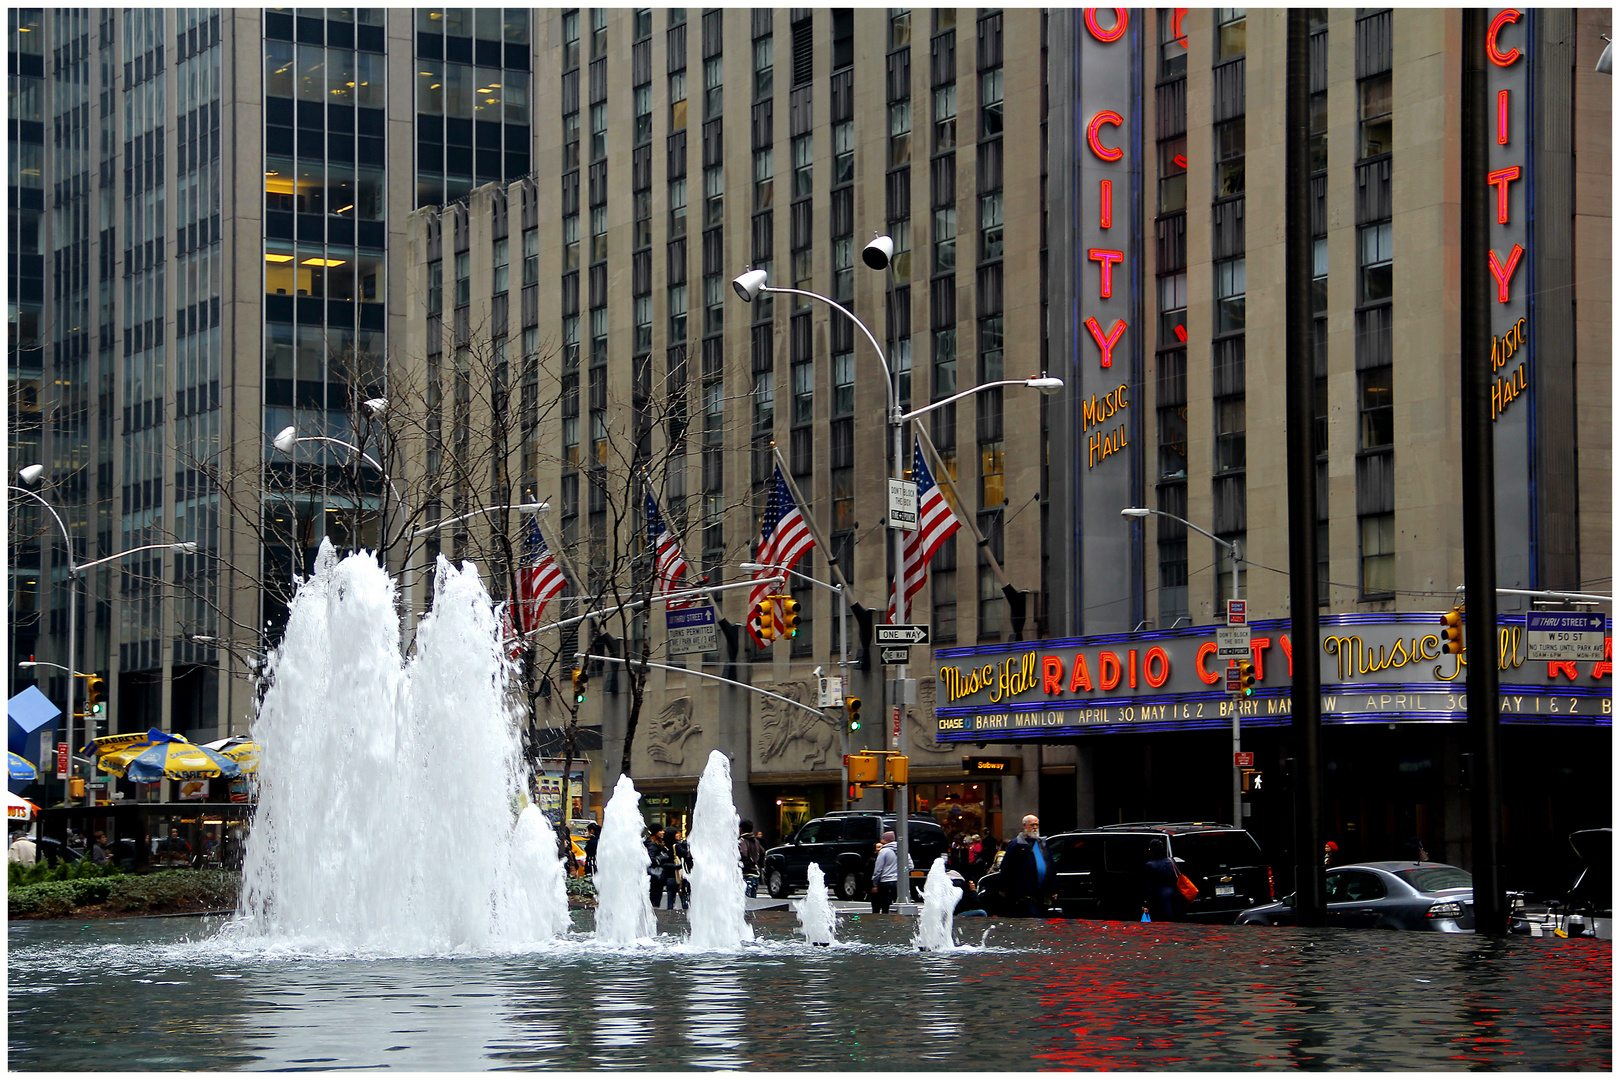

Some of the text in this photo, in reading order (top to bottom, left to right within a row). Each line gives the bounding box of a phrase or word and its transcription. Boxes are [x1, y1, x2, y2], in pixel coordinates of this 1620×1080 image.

[1487, 8, 1523, 303] CITY
[1086, 109, 1128, 368] CITY
[1491, 363, 1527, 420] HALL
[1083, 384, 1128, 432] MUSIC
[1089, 425, 1128, 468] HALL
[895, 497, 903, 506] THE
[686, 612, 703, 622] STREET
[1540, 617, 1588, 627] THRU STREET
[686, 626, 713, 636] PERMITTED
[1549, 633, 1583, 641] W 50 ST
[1323, 635, 1440, 680] Music
[939, 651, 1038, 703] Music Hall
[1042, 646, 1169, 696] RADIO
[976, 714, 1008, 729] BARRY
[1015, 711, 1064, 727] MANILOW
[1078, 708, 1110, 723] APRIL
[1141, 705, 1166, 720] MAY
[1183, 704, 1190, 718] &
[1196, 703, 1204, 718] 2
[1219, 700, 1259, 716] BARRY
[1366, 694, 1427, 710] APRIL
[1501, 696, 1522, 712] AY
[1550, 697, 1559, 713] &
[1569, 698, 1578, 713] 2
[938, 718, 964, 730] CHASE
[97, 734, 144, 746] SABRETT
[168, 770, 216, 780] SABRETT
[977, 761, 1004, 770] Subway
